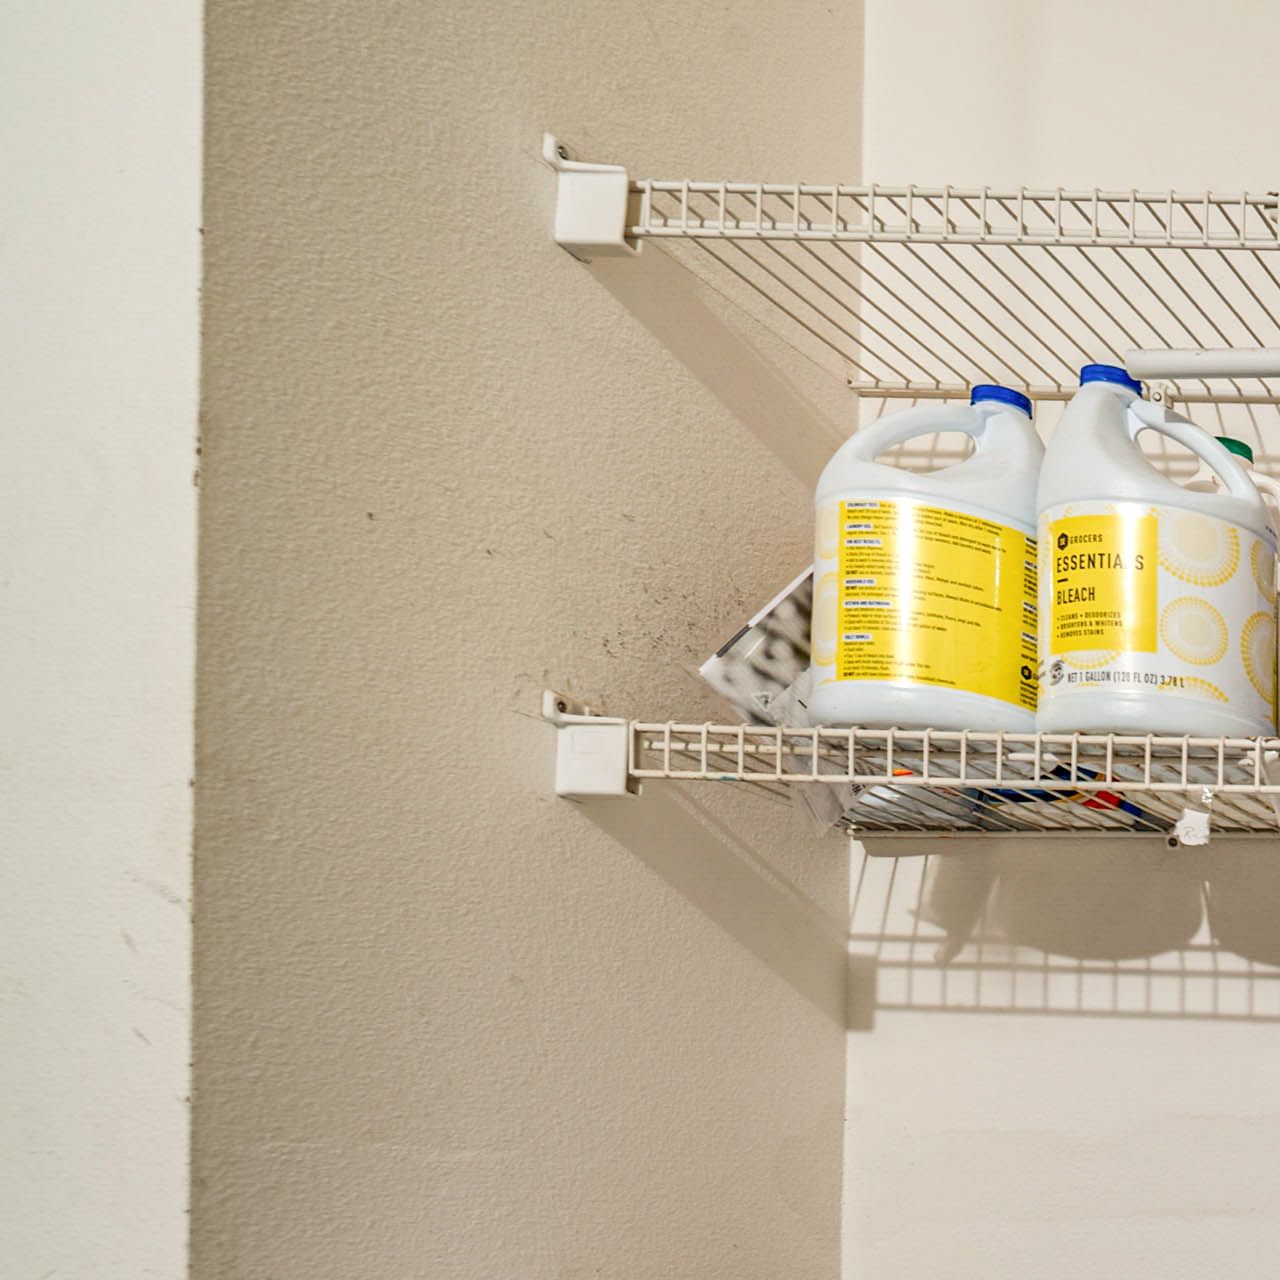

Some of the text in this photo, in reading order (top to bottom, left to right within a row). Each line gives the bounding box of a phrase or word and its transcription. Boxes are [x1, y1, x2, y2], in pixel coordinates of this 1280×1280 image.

[1070, 534, 1103, 545] GROCERS
[1056, 552, 1145, 573] ESSENTIAS
[1057, 587, 1096, 605] BLEACH
[1067, 672, 1078, 683] NET
[1085, 671, 1112, 683] GALLON
